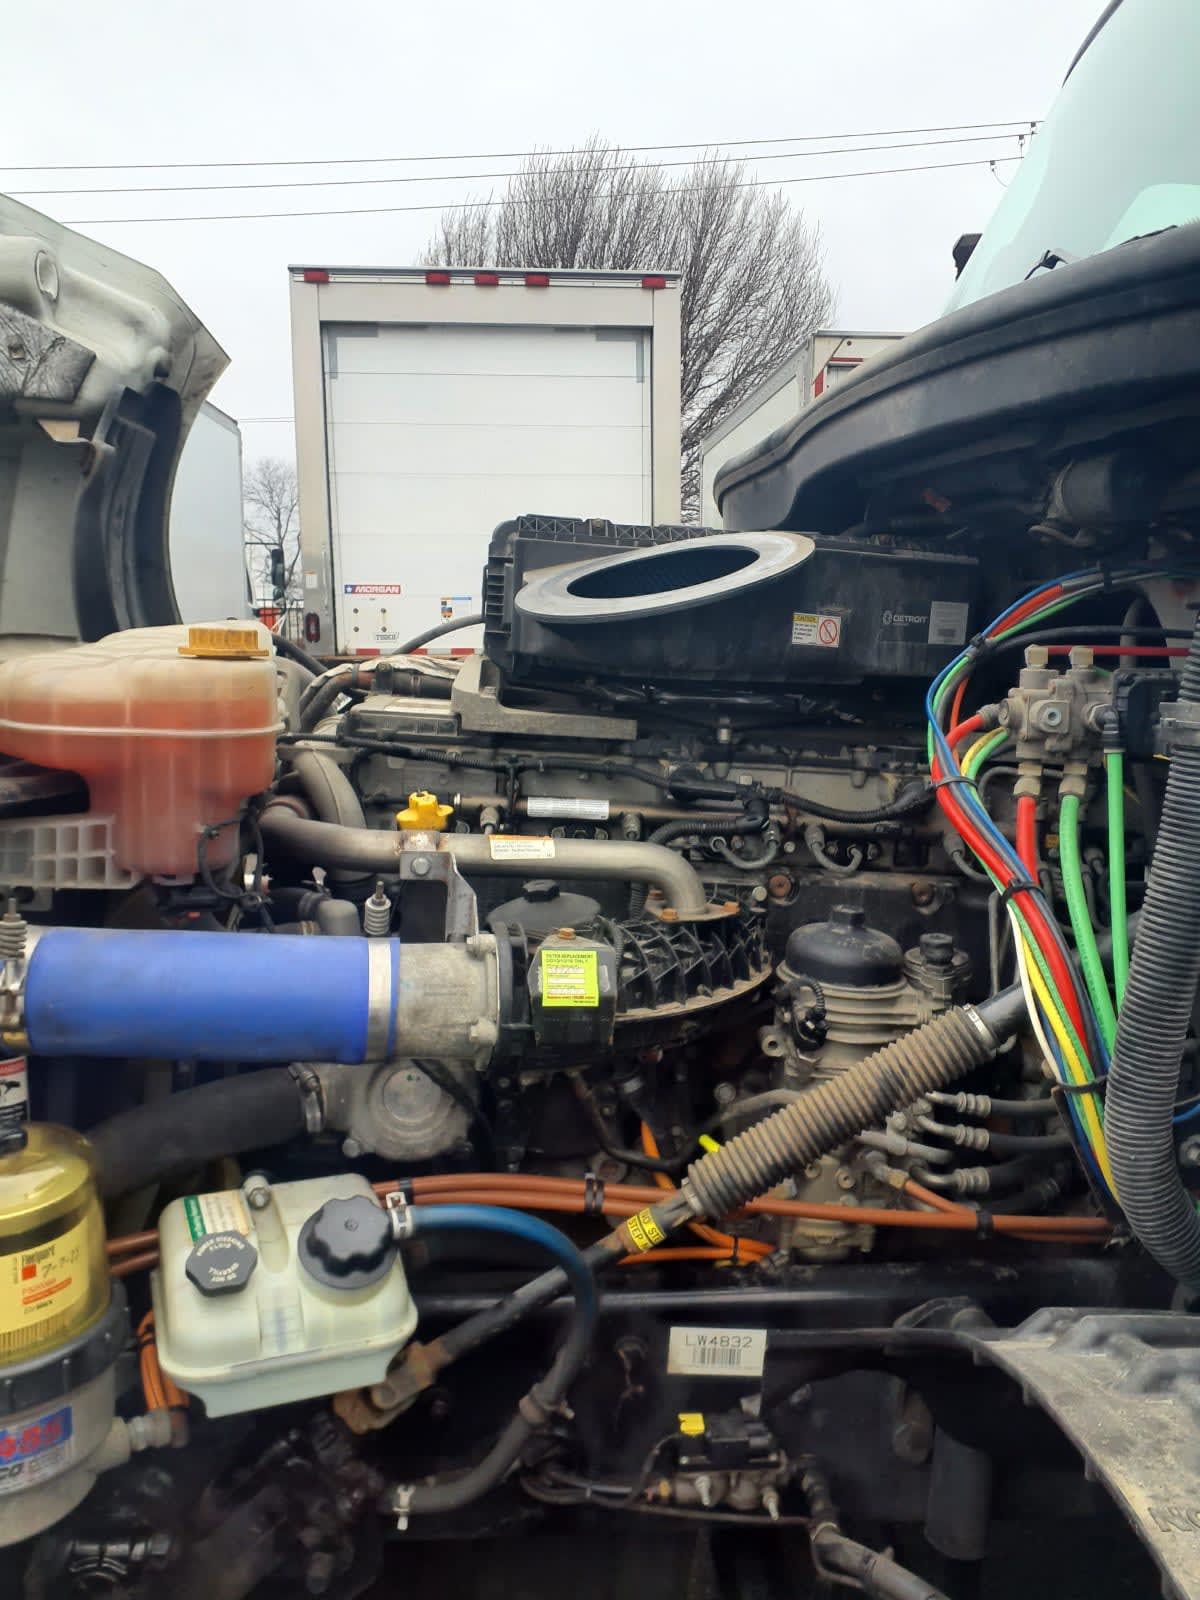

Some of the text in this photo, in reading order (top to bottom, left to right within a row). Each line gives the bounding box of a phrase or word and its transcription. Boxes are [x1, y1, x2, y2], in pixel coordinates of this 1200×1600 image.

[354, 585, 400, 594] MORGAN
[893, 615, 928, 624] DETROIT
[685, 1333, 753, 1349] LW4832
